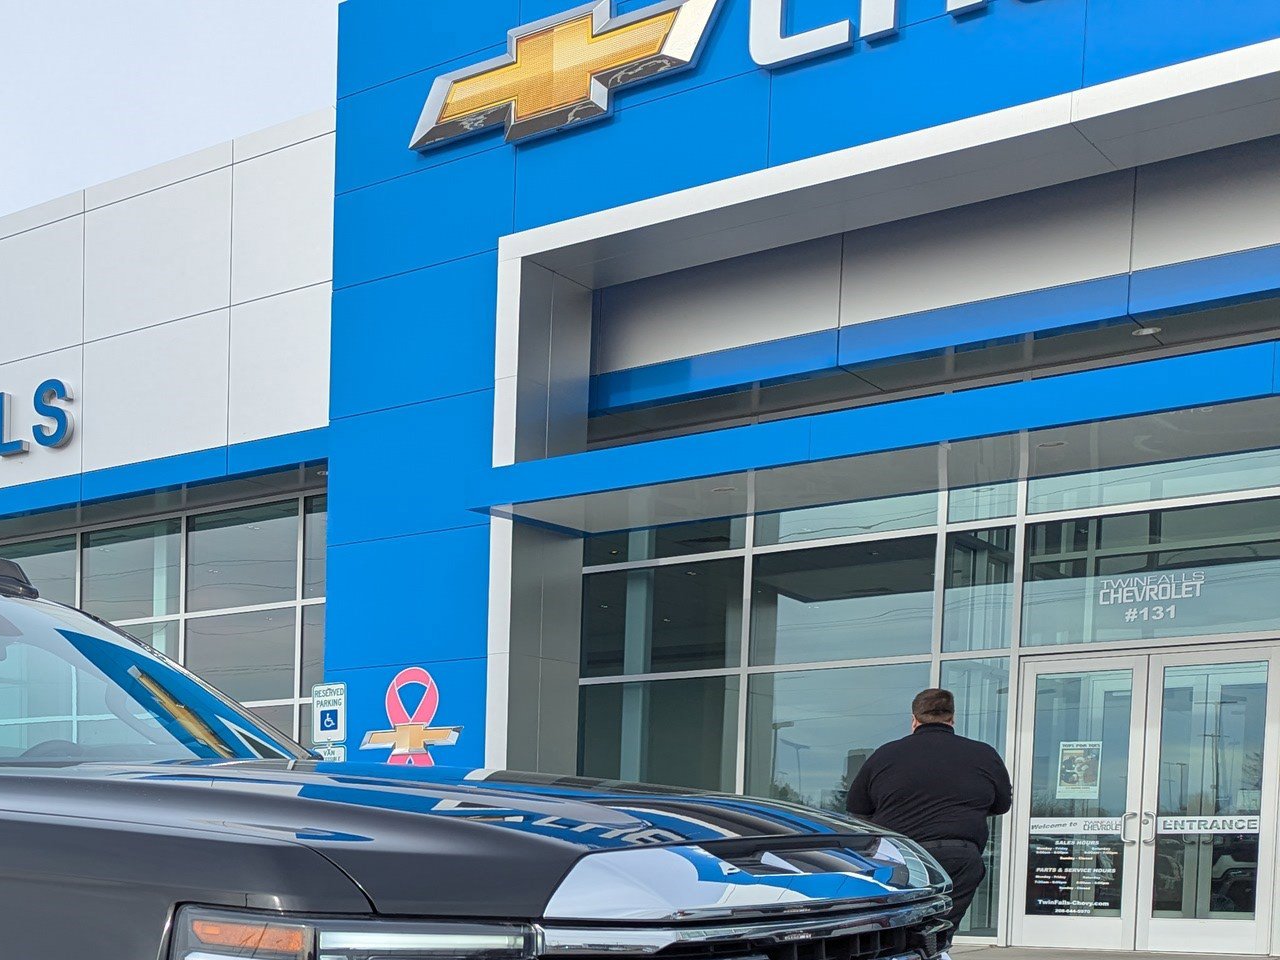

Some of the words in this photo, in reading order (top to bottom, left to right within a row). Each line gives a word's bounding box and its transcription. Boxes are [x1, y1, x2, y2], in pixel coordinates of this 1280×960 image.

[1100, 571, 1205, 590] TWINFALLS
[1099, 581, 1205, 605] CHEVROLET
[1125, 604, 1176, 623] #131
[314, 688, 345, 698] RESERVED
[316, 699, 342, 708] PARKING
[1162, 819, 1258, 831] ENTRANCE
